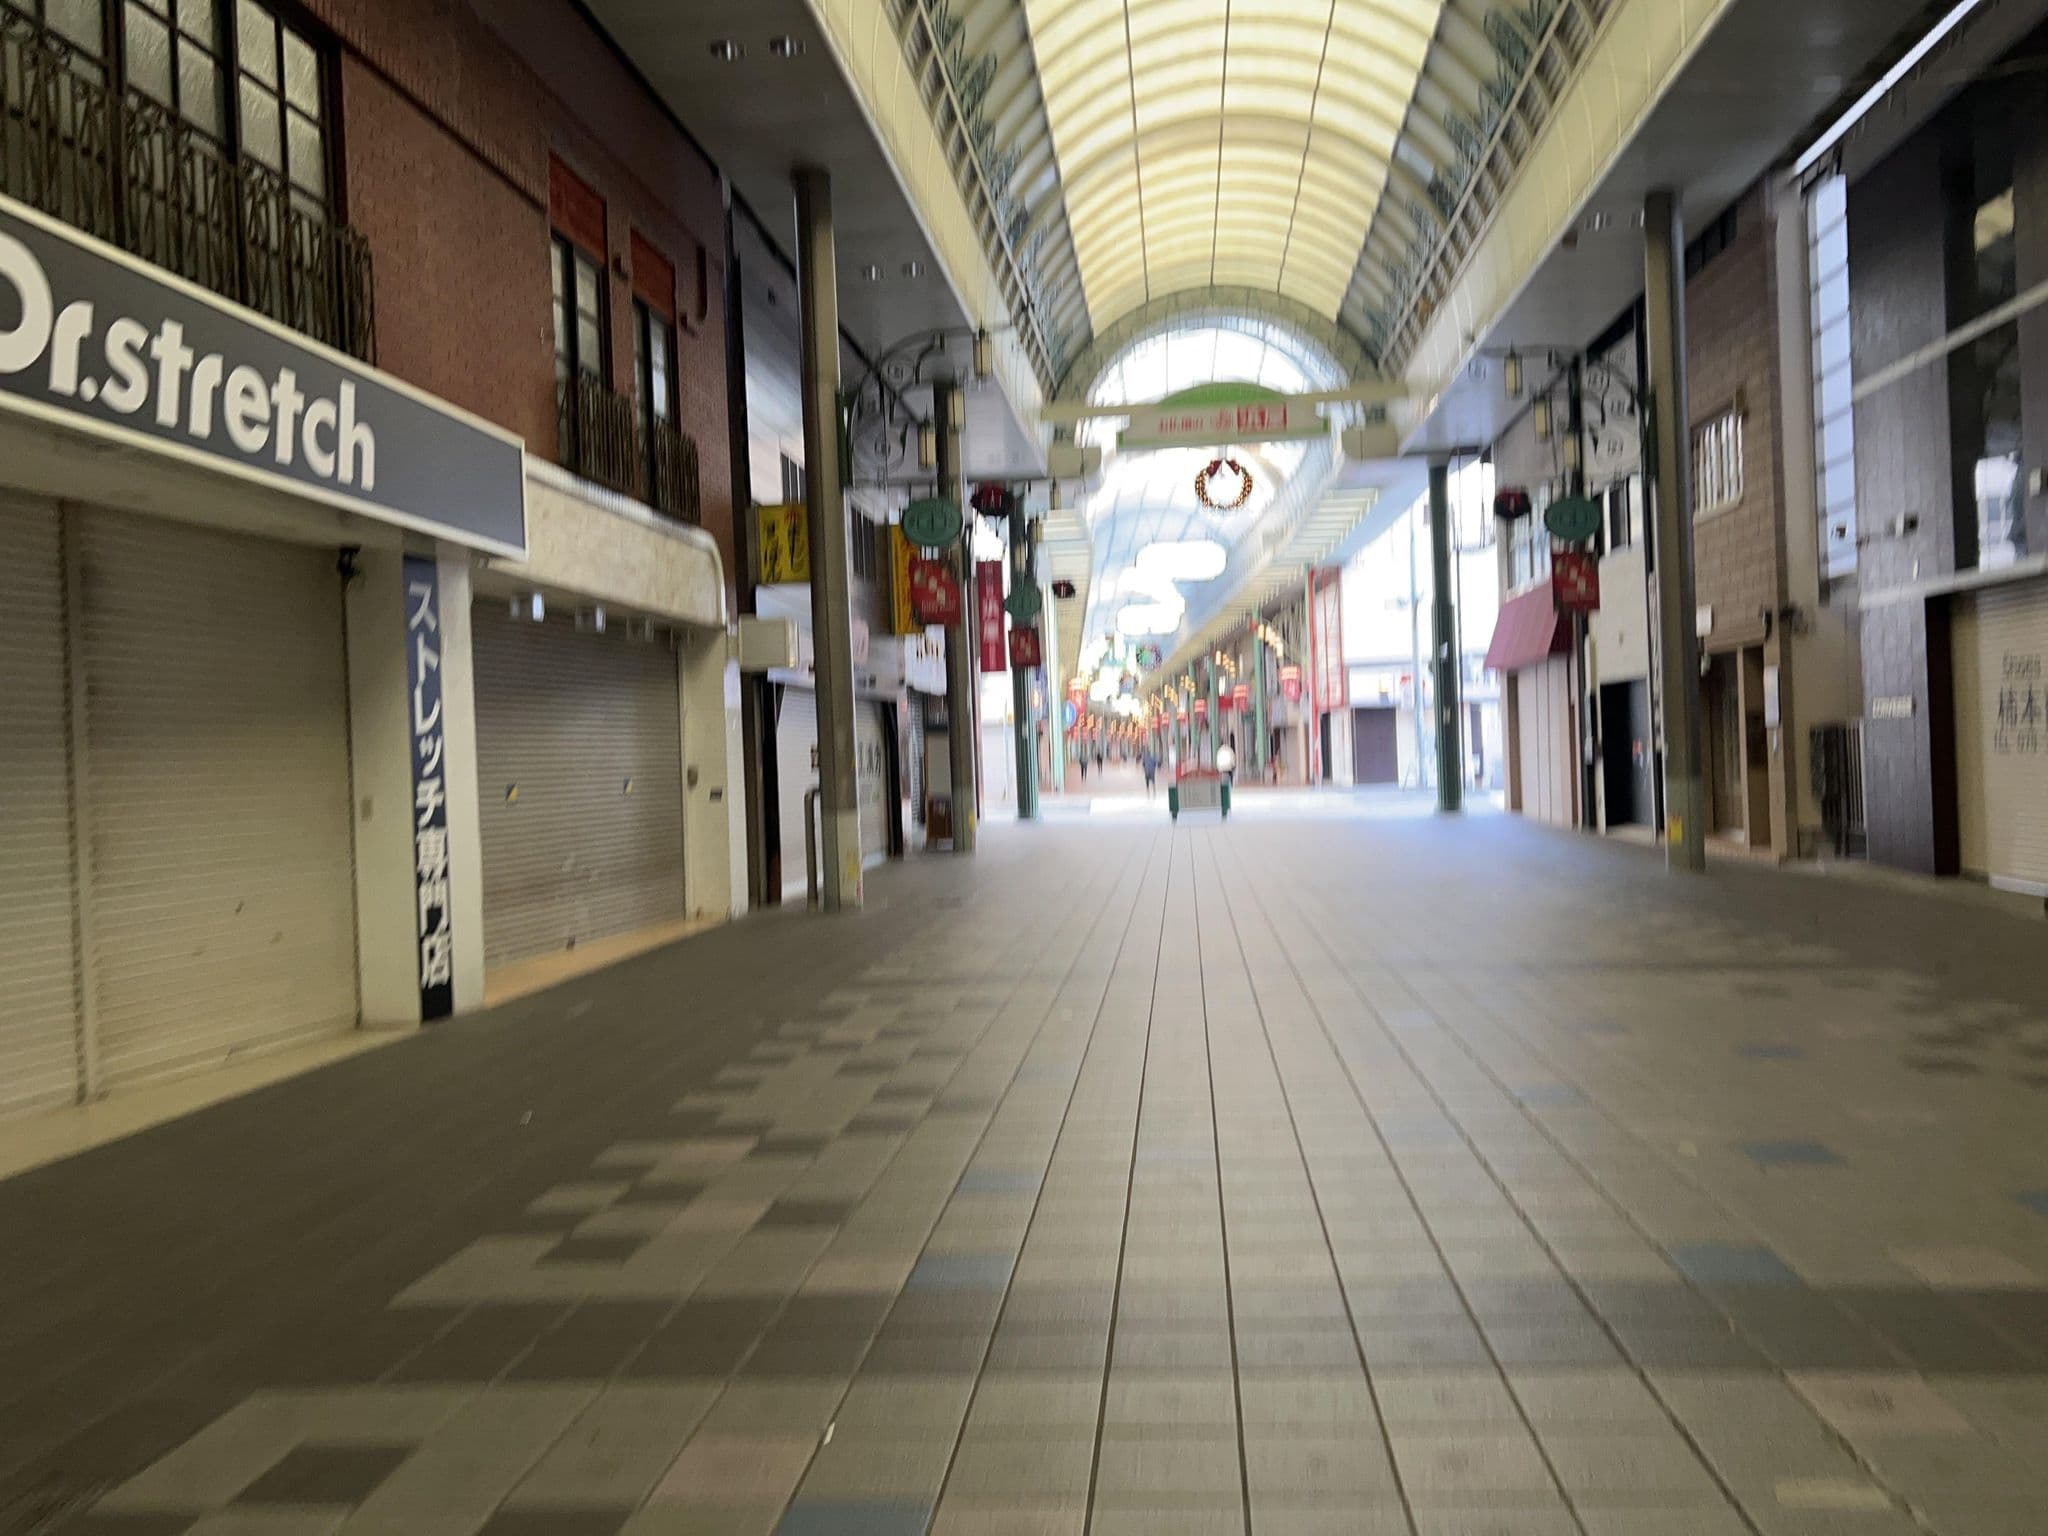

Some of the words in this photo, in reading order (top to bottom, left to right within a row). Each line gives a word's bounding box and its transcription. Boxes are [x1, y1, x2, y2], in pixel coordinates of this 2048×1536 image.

[408, 582, 452, 988] ストレッチ専門店
